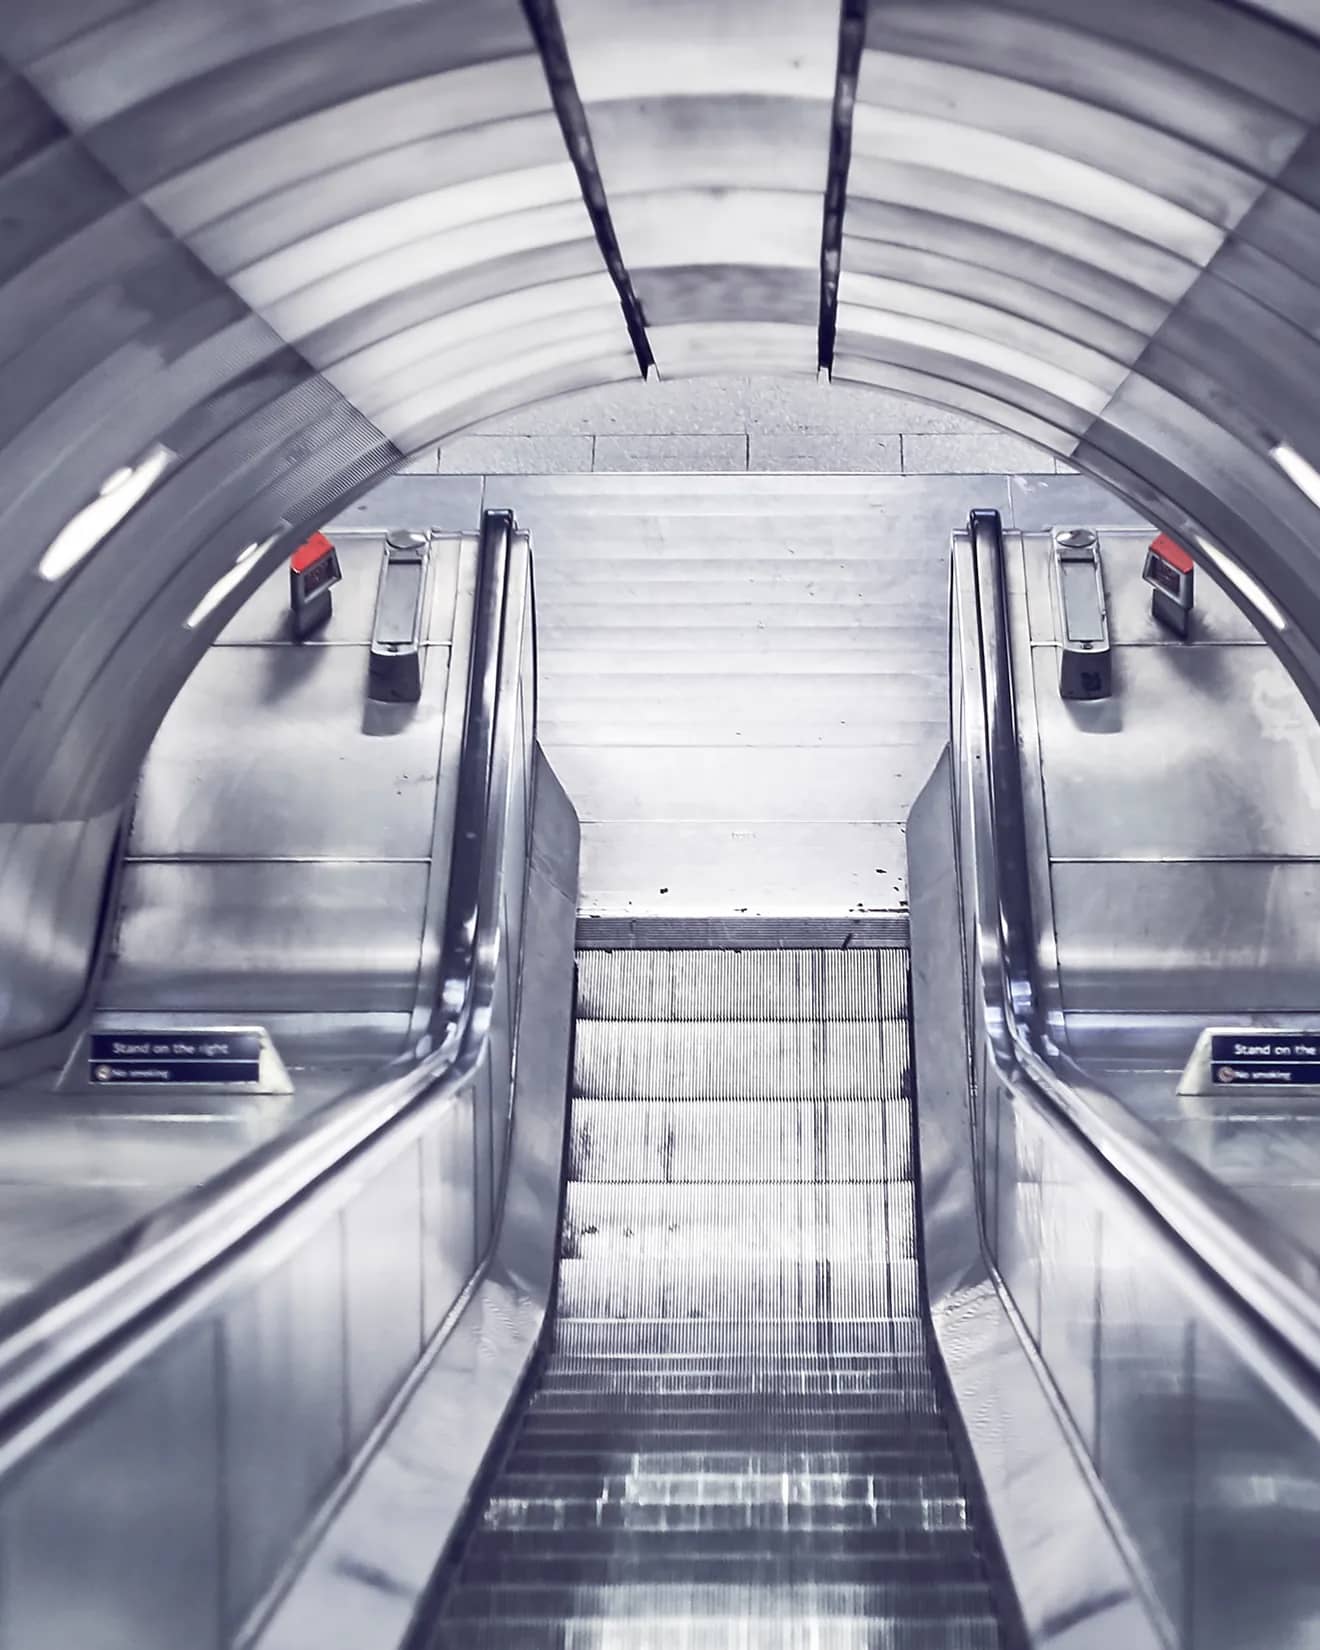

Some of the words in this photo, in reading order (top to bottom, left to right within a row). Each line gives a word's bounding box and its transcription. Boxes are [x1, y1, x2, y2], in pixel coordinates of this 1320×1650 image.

[112, 1042, 150, 1055] Stand
[154, 1045, 169, 1055] on
[173, 1043, 194, 1055] the
[200, 1043, 229, 1057] right
[1234, 1043, 1270, 1055] Stand
[1275, 1045, 1291, 1055] on
[1295, 1044, 1317, 1055] the
